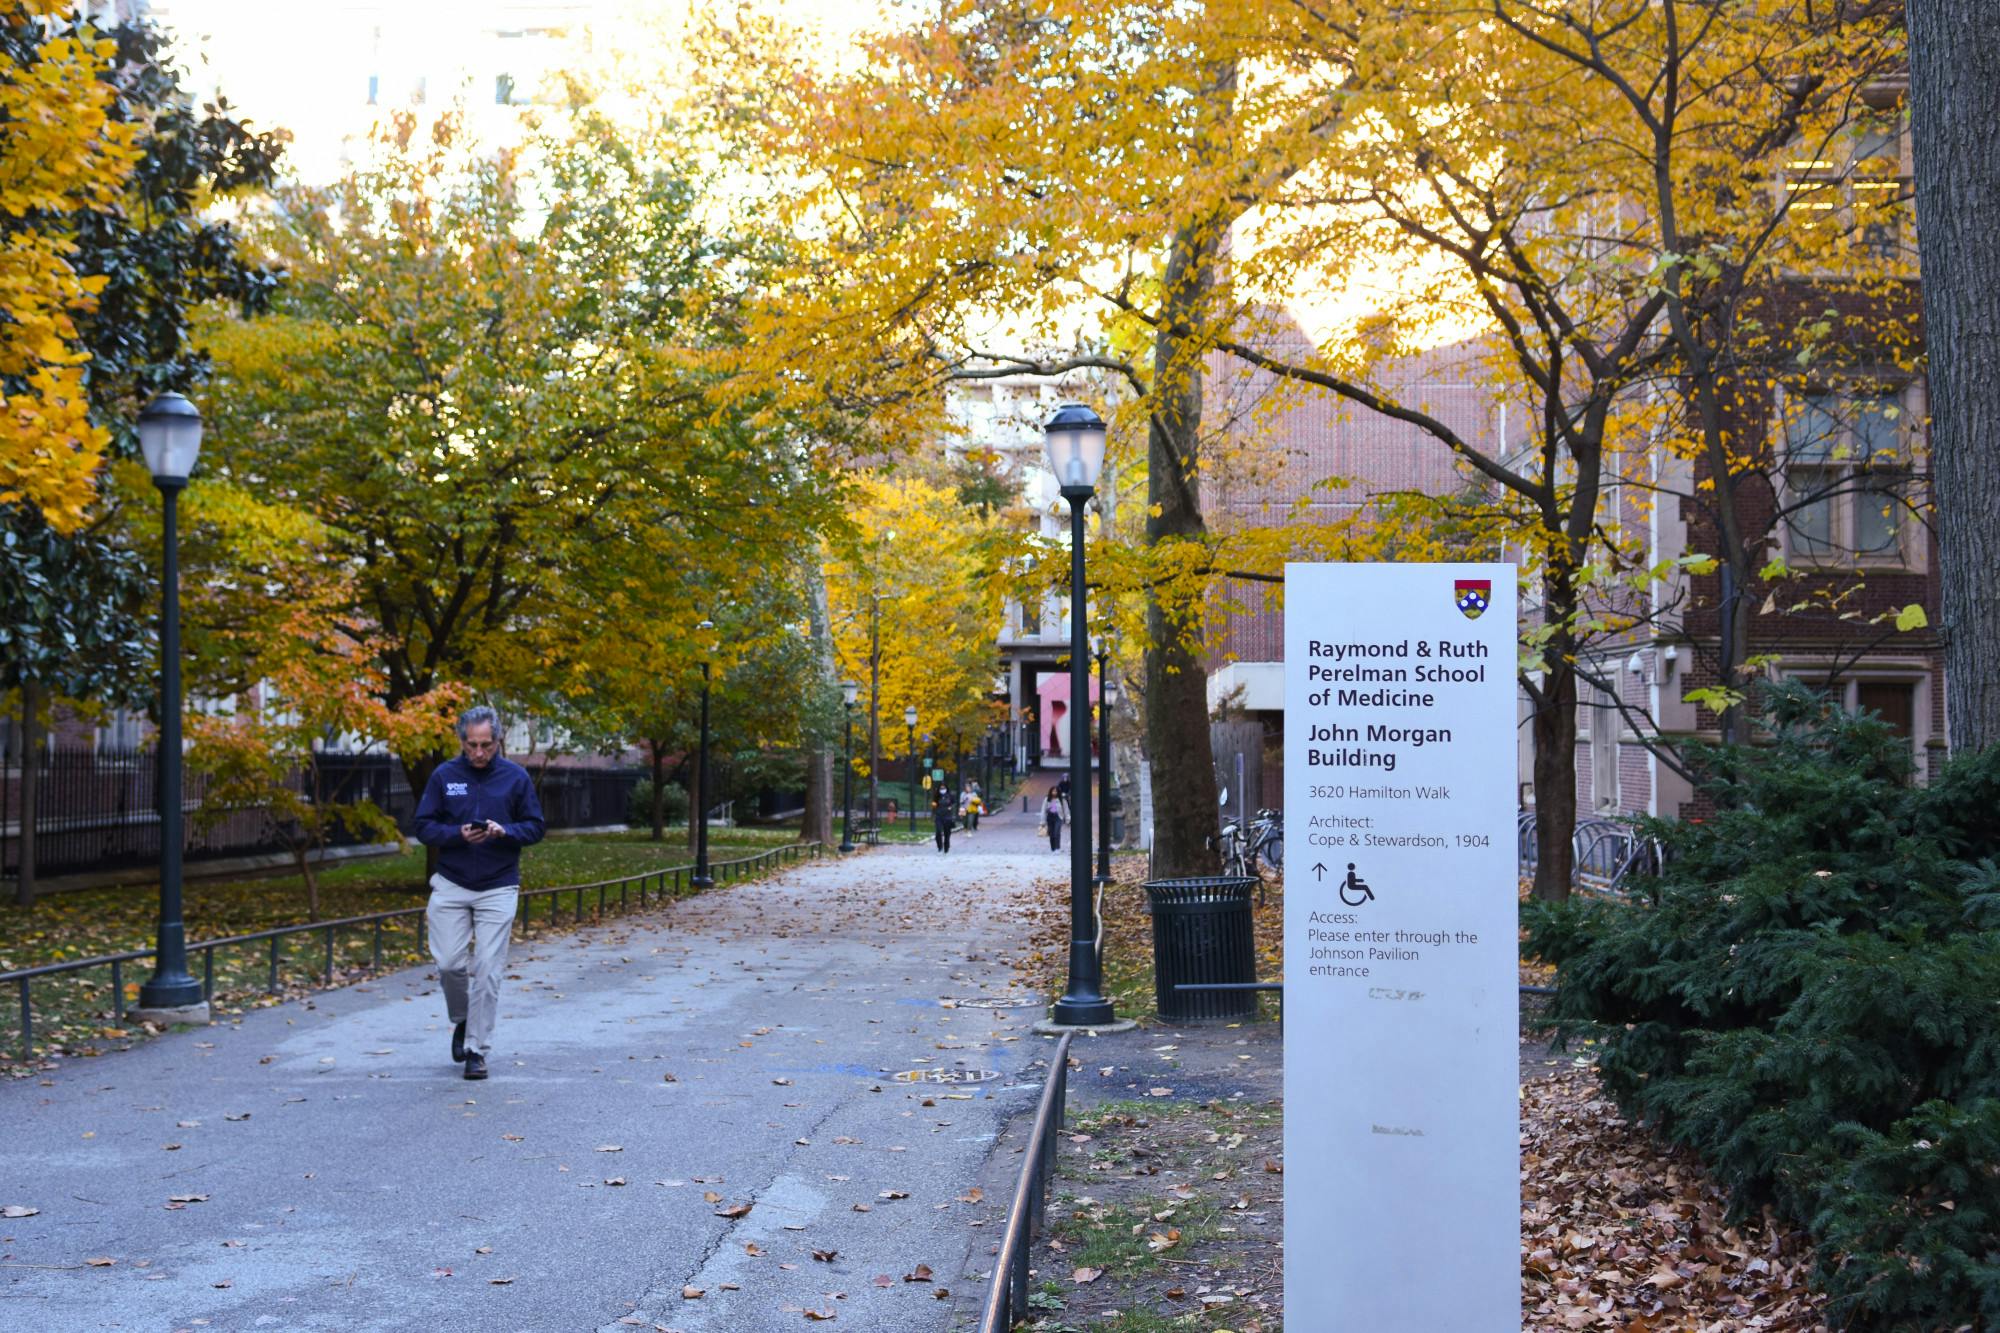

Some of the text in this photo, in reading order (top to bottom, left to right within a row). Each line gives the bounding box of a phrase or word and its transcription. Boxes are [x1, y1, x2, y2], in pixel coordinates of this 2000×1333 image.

[1309, 640, 1488, 662] Raymond & Ruth
[1309, 664, 1484, 682] Perelman School
[1309, 688, 1434, 707] of Medicine
[1309, 724, 1451, 747] John Morgan
[1308, 748, 1396, 771] Building
[1309, 786, 1450, 799] 3620 Hamilton Walk
[1309, 815, 1373, 828] Architect:
[1309, 833, 1490, 848] Cope & Stewardson, 1904
[1309, 911, 1357, 924] Access:
[1309, 929, 1477, 945] Please enter through the
[1309, 947, 1419, 960] Johnson Pavilion
[1309, 964, 1369, 977] entrance
